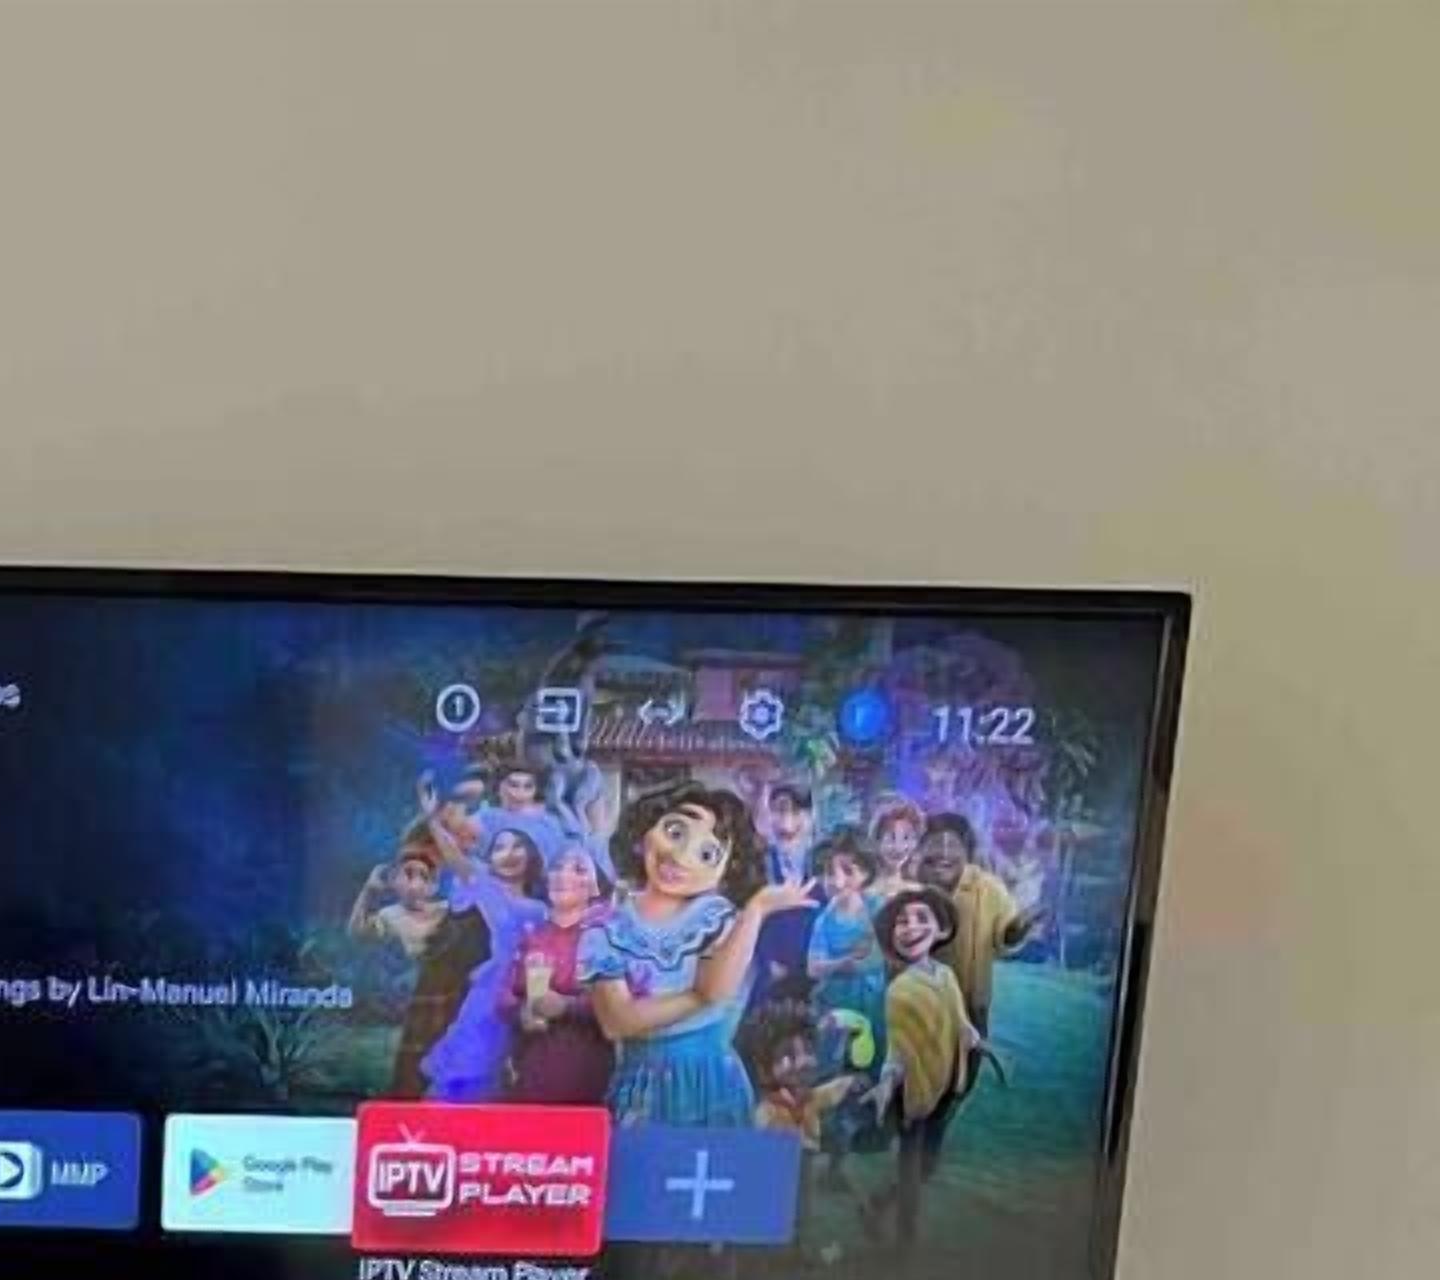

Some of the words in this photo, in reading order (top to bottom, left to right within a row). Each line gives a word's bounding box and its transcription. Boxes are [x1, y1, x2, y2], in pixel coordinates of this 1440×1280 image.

[933, 706, 1035, 745] 11:22
[48, 976, 81, 1008] by
[88, 977, 237, 1005] Lin-Manuel
[246, 980, 354, 1009] Miranda
[243, 1155, 297, 1174] Google
[303, 1156, 333, 1176] Play
[378, 1161, 446, 1194] IPTV
[460, 1151, 594, 1177] STREAM
[460, 1183, 593, 1207] PLAYER
